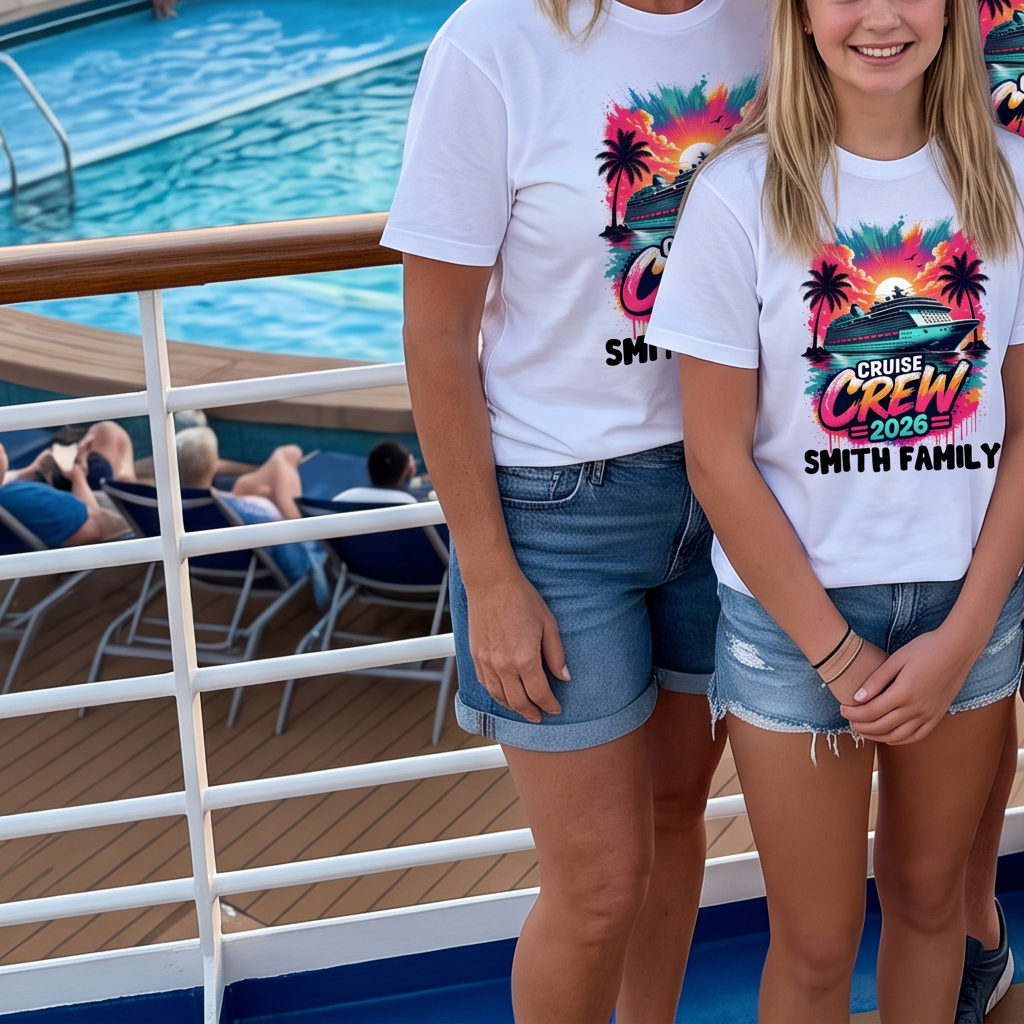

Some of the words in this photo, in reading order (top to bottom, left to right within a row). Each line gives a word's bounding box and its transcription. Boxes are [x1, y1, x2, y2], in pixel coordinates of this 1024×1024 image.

[605, 334, 672, 366] SMI
[857, 355, 923, 378] CRUISE
[820, 360, 971, 428] CREW
[870, 413, 929, 441] 2026
[804, 446, 891, 475] SMITH
[899, 442, 1001, 471] FAMILY
